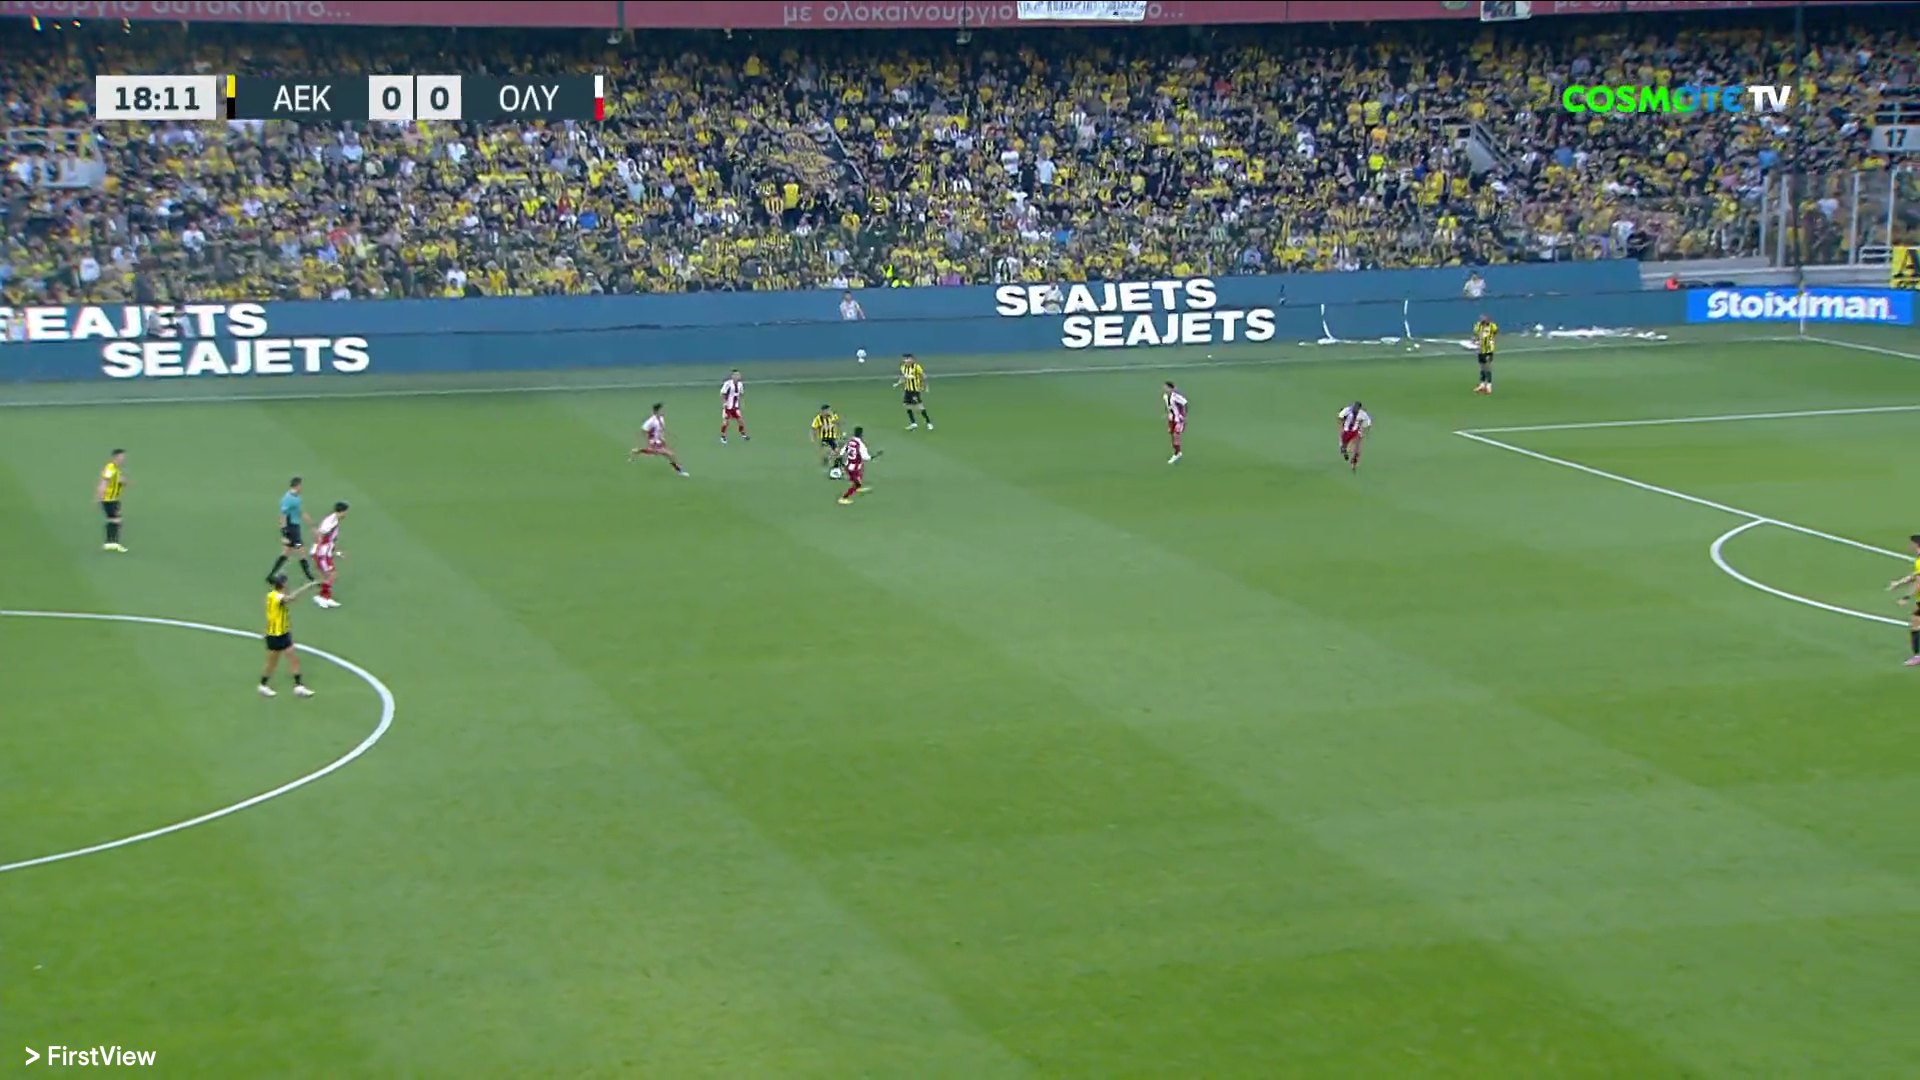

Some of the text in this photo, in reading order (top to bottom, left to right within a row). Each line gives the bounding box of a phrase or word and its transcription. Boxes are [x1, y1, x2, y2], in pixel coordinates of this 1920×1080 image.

[783, 5, 812, 26] με
[1884, 128, 1908, 148] 17
[1707, 290, 1890, 320] Stoiximan
[1061, 308, 1276, 348] SEAJETS
[102, 337, 370, 378] SEAJETS
